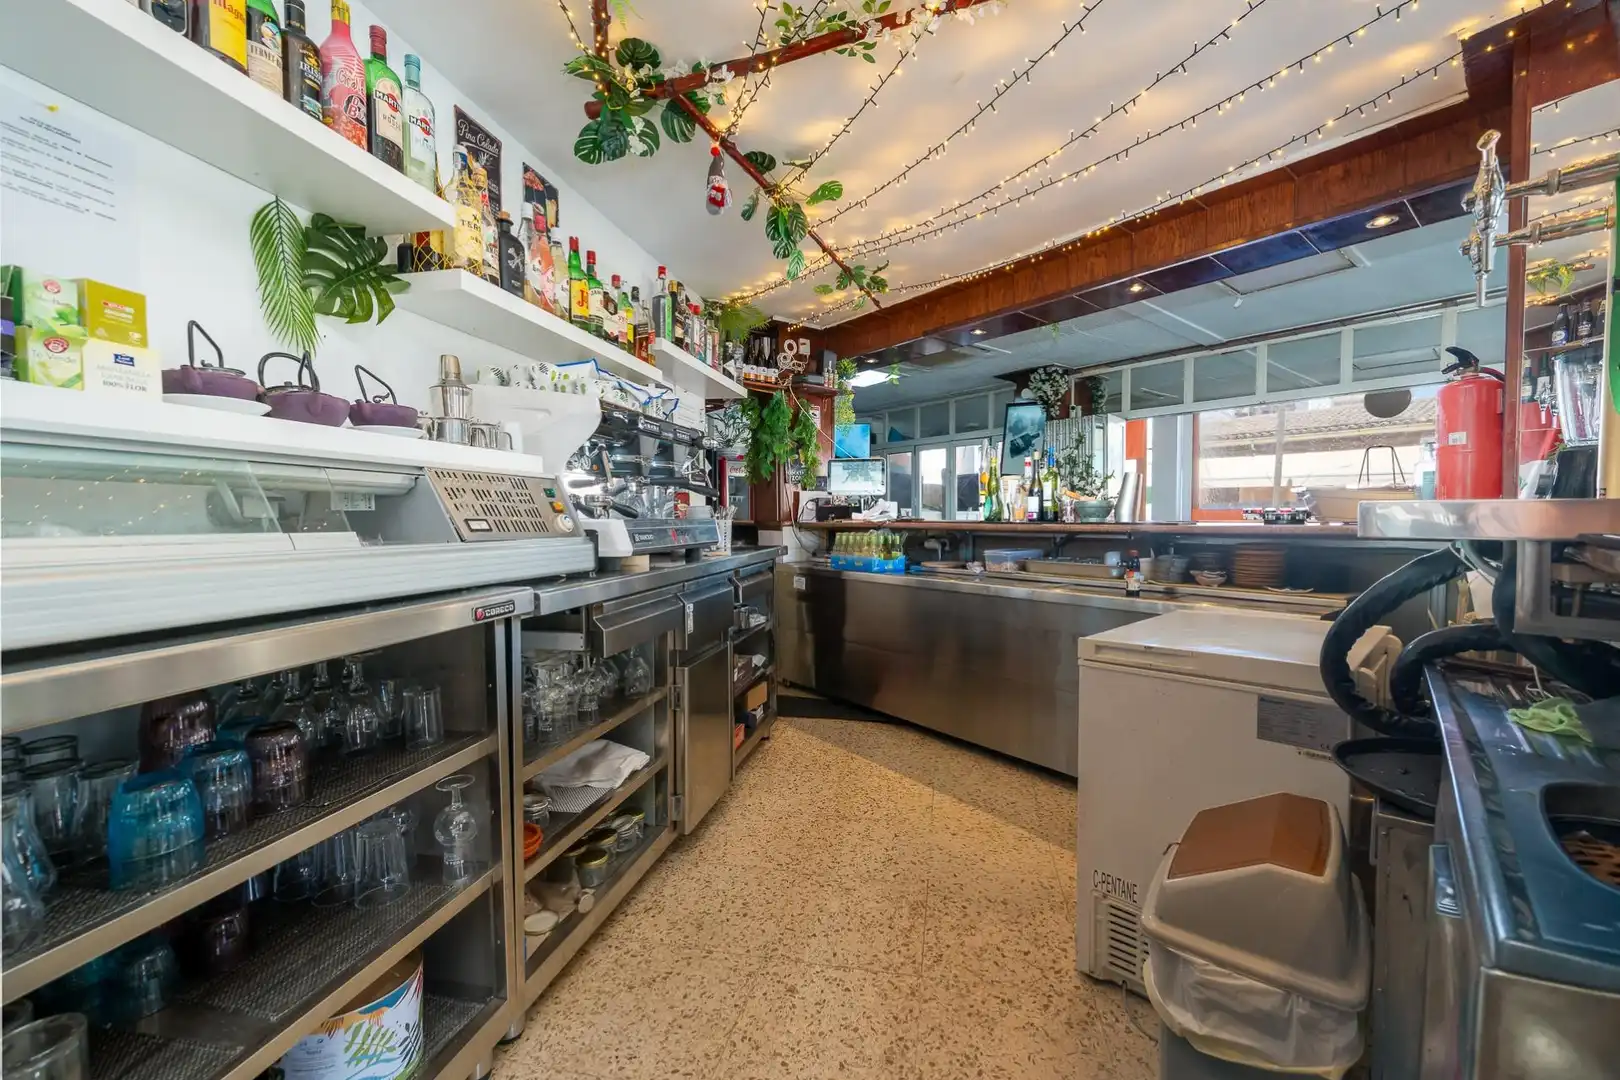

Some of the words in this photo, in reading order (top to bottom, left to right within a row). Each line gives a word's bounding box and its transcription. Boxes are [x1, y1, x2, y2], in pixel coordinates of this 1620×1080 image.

[476, 133, 500, 154] Colada
[485, 604, 514, 617] CORECO
[1093, 869, 1138, 904] C-PENTANE
